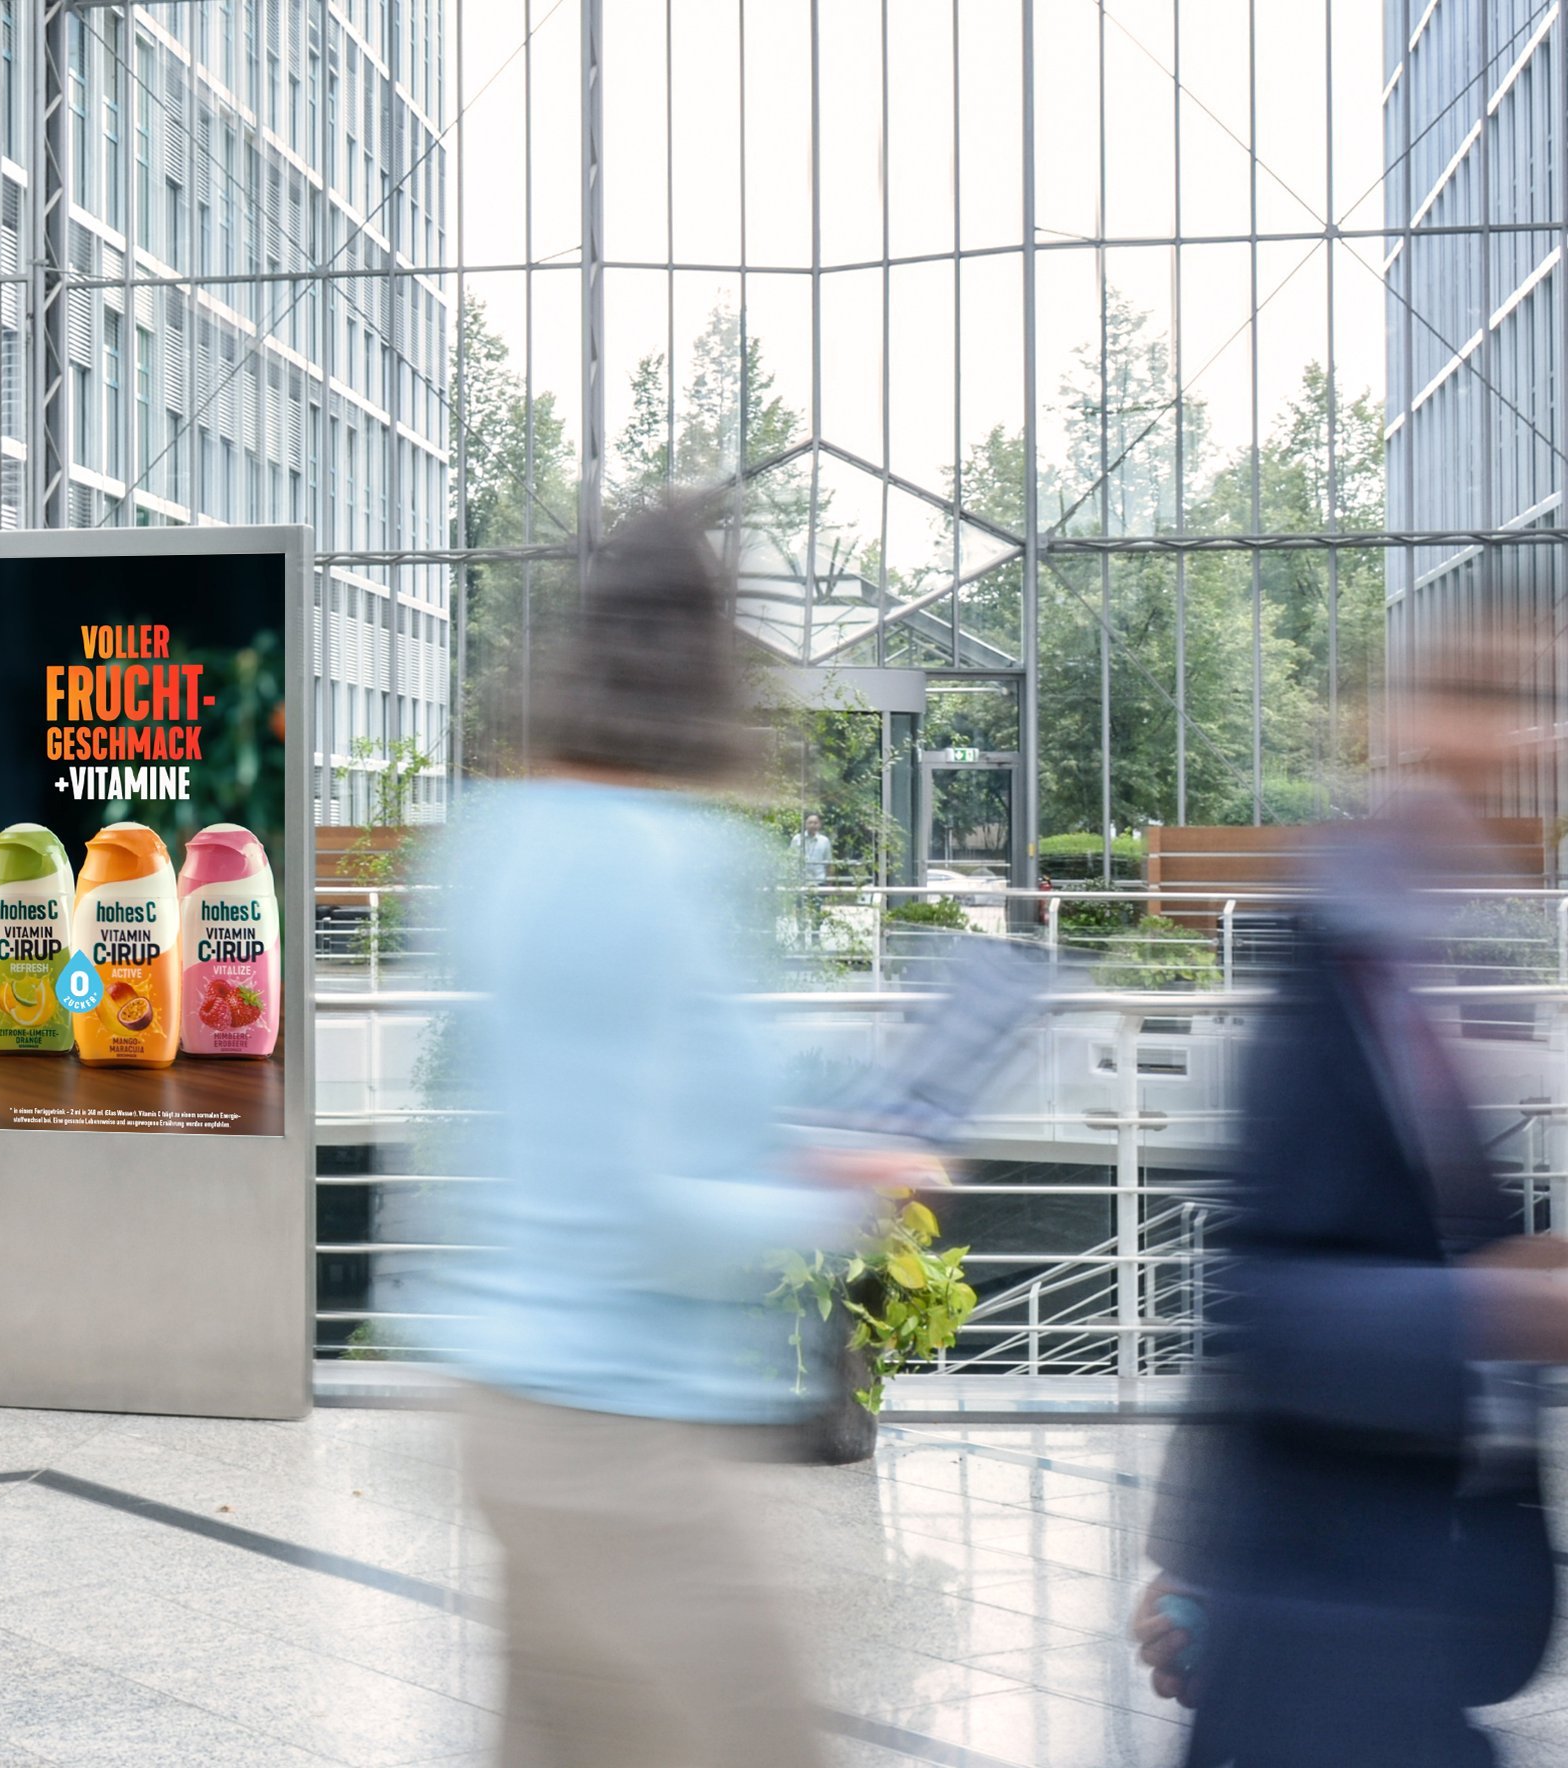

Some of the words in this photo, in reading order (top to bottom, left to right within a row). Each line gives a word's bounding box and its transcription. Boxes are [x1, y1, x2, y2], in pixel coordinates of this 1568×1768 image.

[81, 624, 170, 660] VOLLER
[46, 664, 216, 722] FRUCHT-
[46, 726, 203, 761] GESCHMACK
[54, 766, 190, 800] +VITAMINE
[0, 899, 47, 920] hohes
[48, 899, 59, 920] C
[96, 900, 145, 923] hohes
[146, 901, 157, 923] C
[201, 900, 249, 921] hohes
[250, 900, 261, 921] C
[4, 926, 53, 938] VITAMIN
[100, 929, 151, 942] VITAMIN
[205, 927, 255, 940] VITAMIN
[10, 963, 49, 973] REFRESH
[111, 968, 143, 979] ACTIVE
[213, 965, 251, 976] VITALIZE
